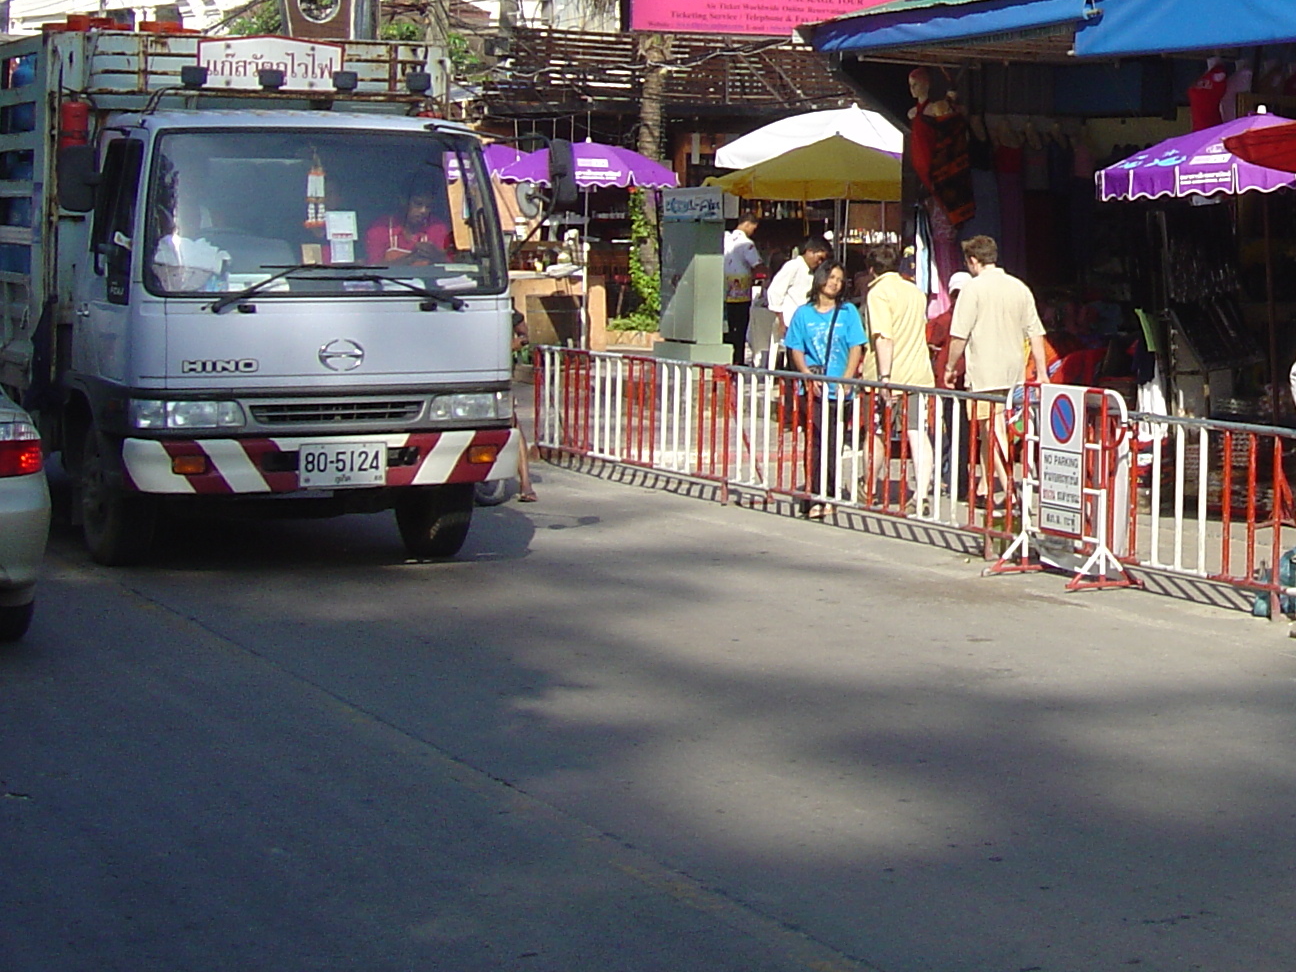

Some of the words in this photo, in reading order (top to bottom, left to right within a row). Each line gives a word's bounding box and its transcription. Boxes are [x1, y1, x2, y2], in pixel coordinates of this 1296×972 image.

[182, 359, 258, 373] HINO
[305, 451, 380, 472] 80-5124
[1044, 454, 1053, 464] NO
[1055, 455, 1078, 468] PARKING
